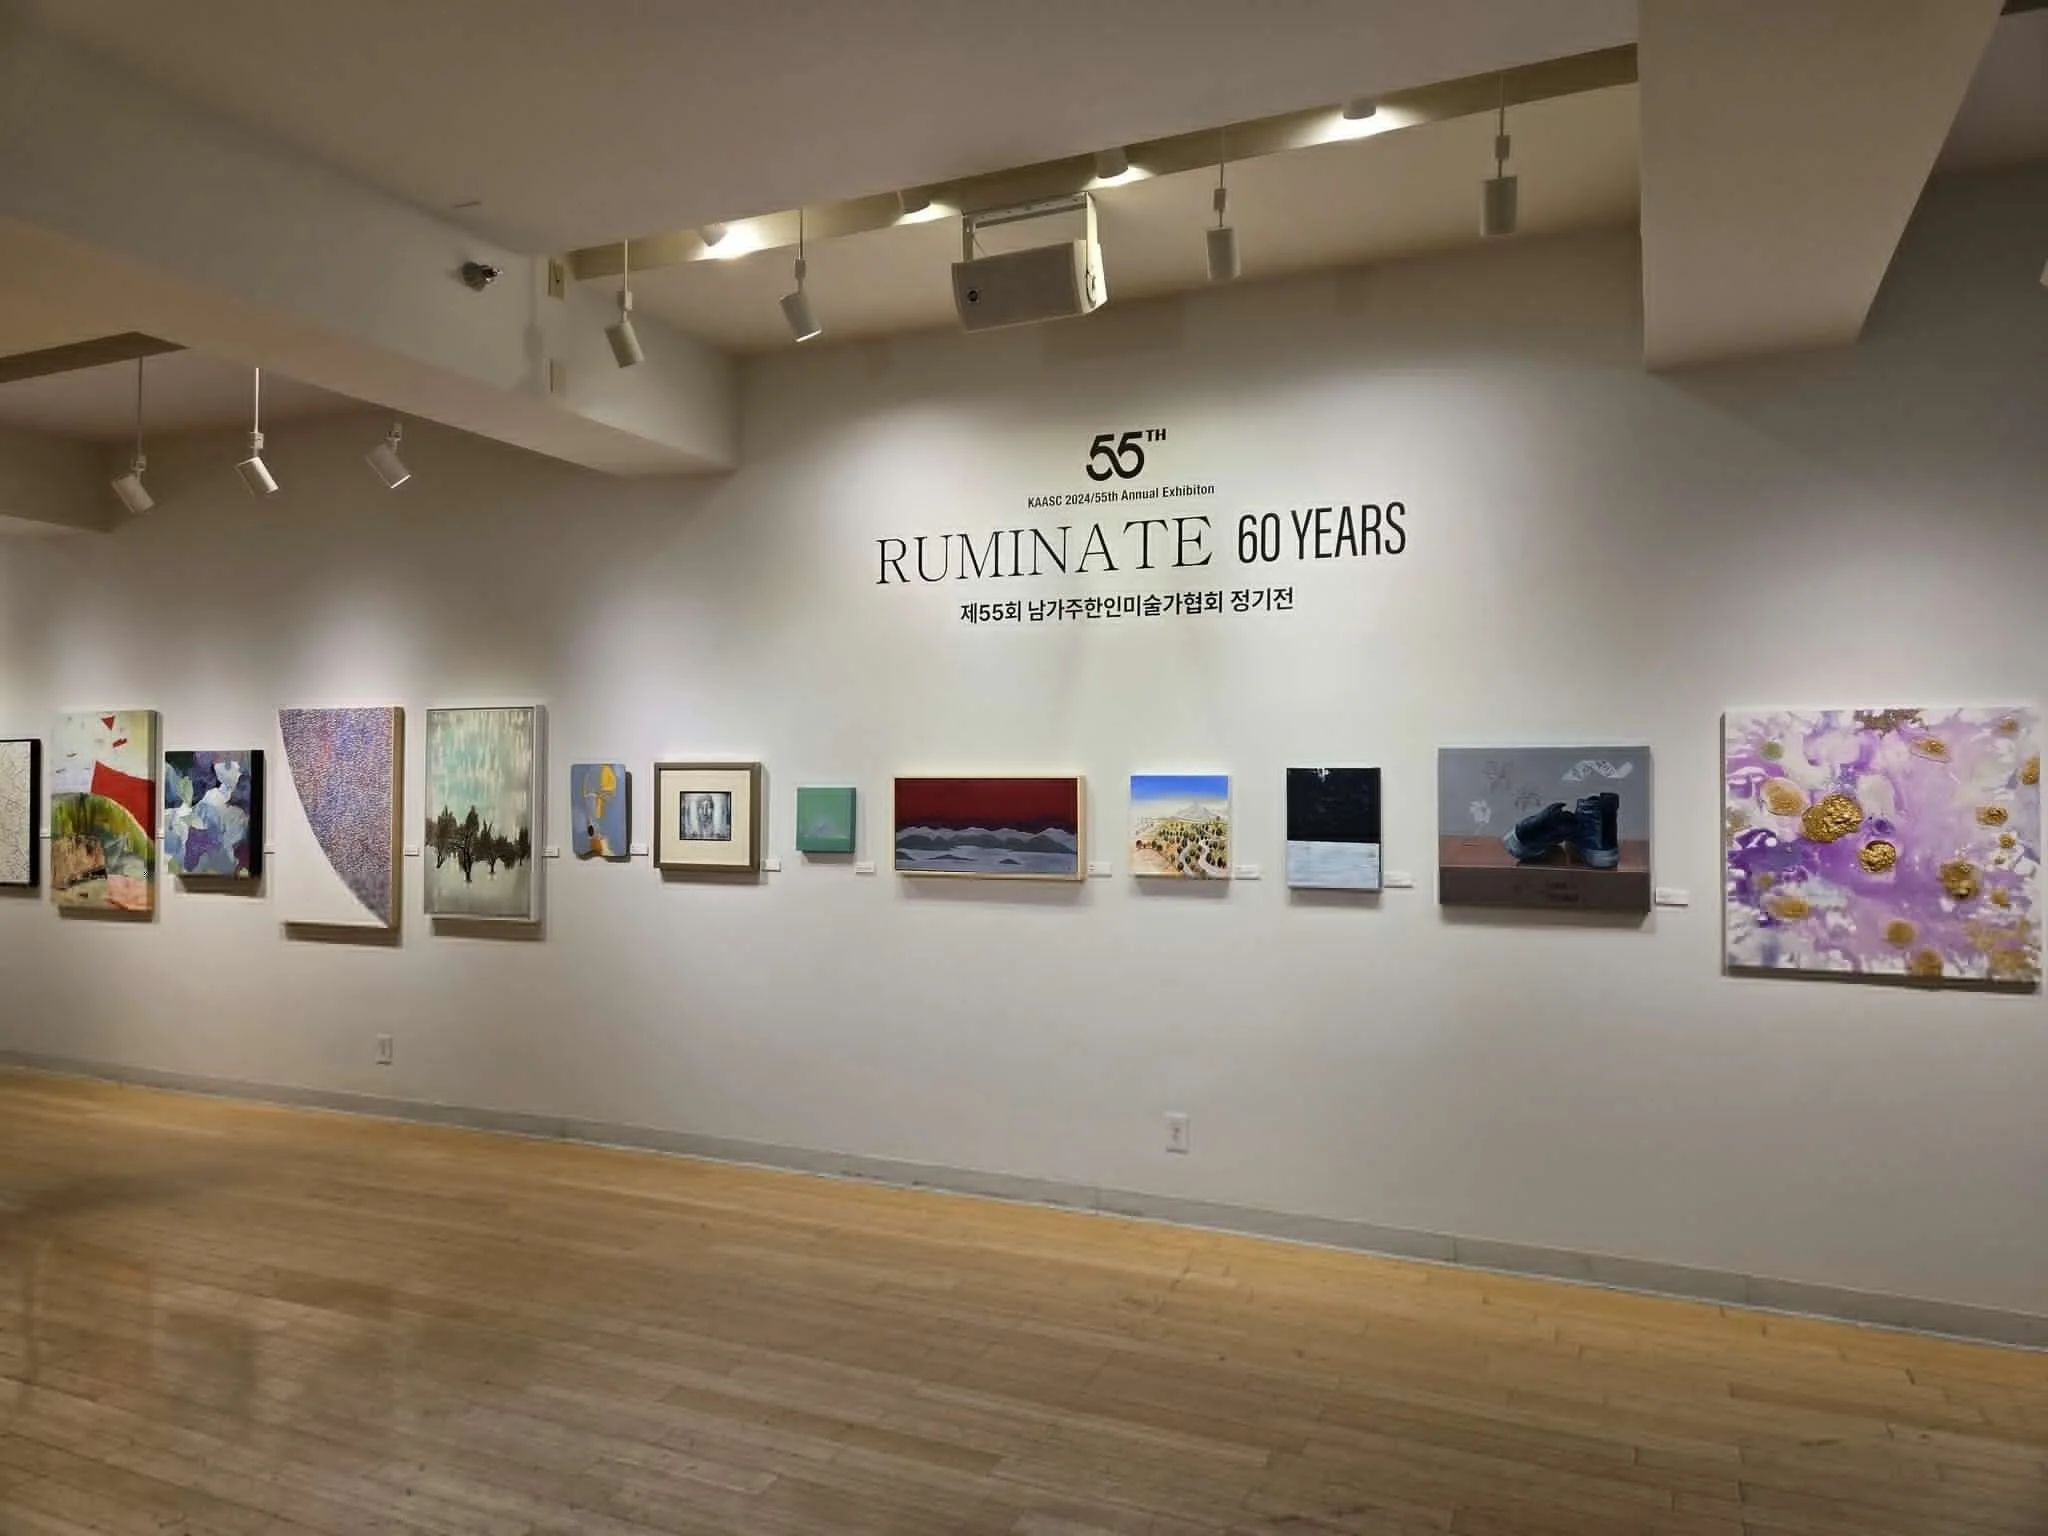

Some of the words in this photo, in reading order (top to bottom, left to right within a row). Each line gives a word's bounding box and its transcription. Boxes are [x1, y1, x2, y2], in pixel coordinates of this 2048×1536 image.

[1028, 496, 1062, 509] KAASC
[1065, 491, 1118, 505] 2024/55th
[1121, 487, 1159, 501] Annual
[1162, 484, 1215, 498] Exhibiton
[876, 515, 1213, 585] RUMINATE
[1238, 513, 1281, 564] 60
[1290, 502, 1407, 560] YEARS
[960, 600, 1022, 624] 제55회
[1027, 592, 1223, 621] 남가주한인미술가협회
[1230, 587, 1293, 612] 정기전
